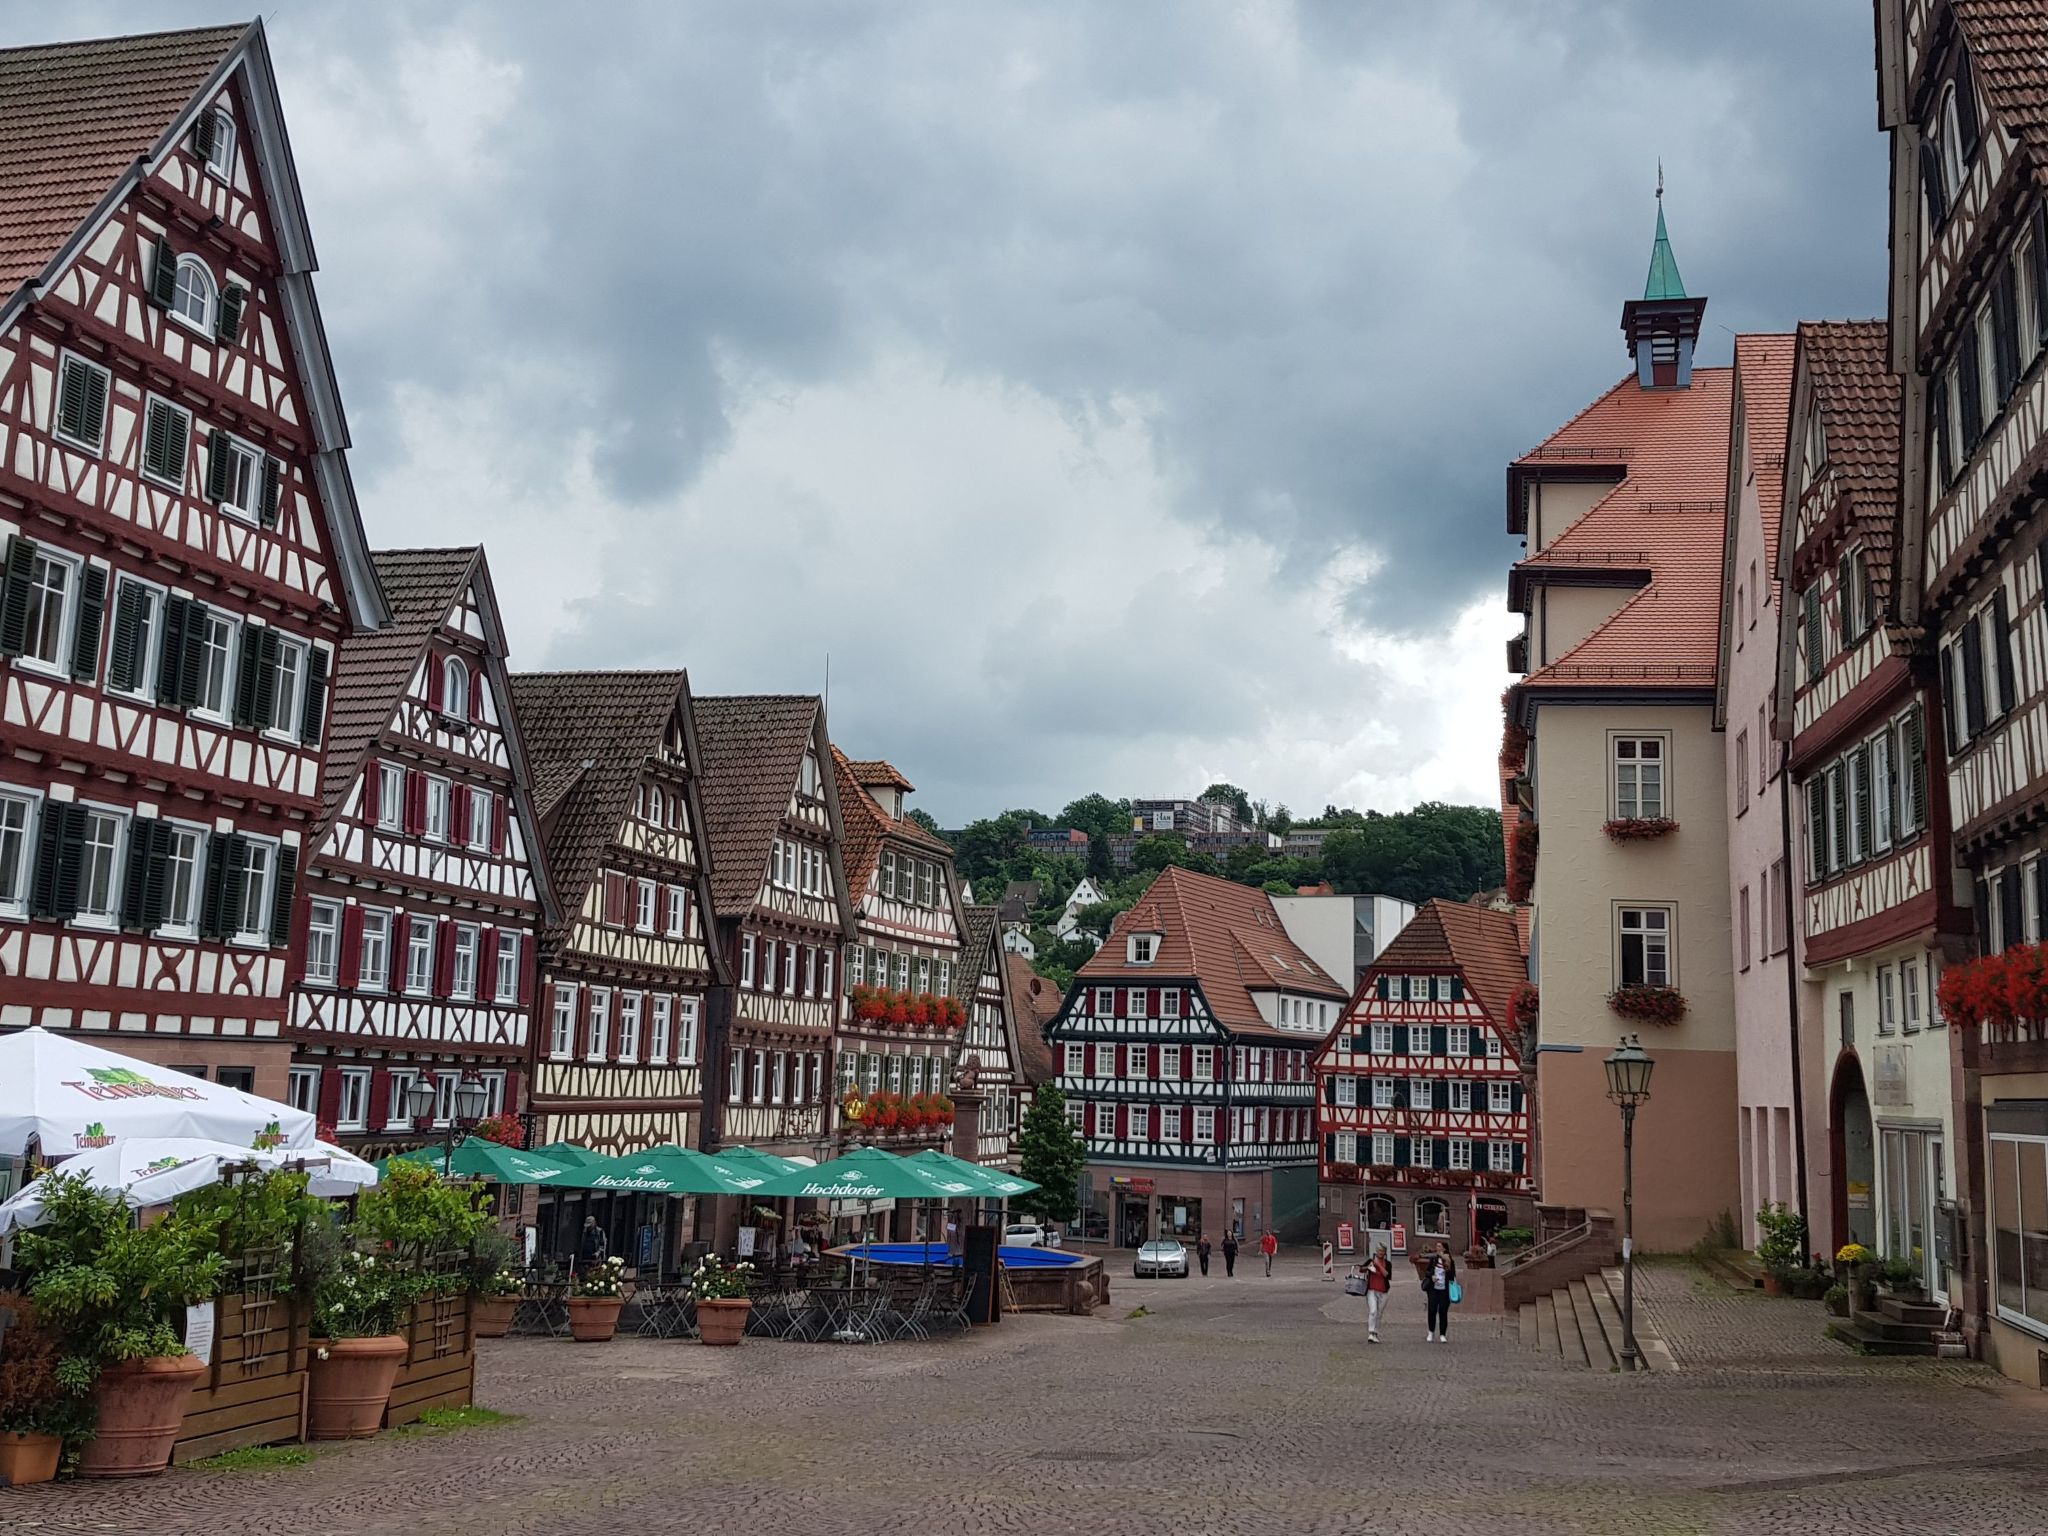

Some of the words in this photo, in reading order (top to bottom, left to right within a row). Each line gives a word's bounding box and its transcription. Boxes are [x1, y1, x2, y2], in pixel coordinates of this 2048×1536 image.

[529, 1115, 537, 1149] HOTE
[592, 1174, 674, 1190] Hochdorfer
[800, 1182, 885, 1196] Hochdorfer
